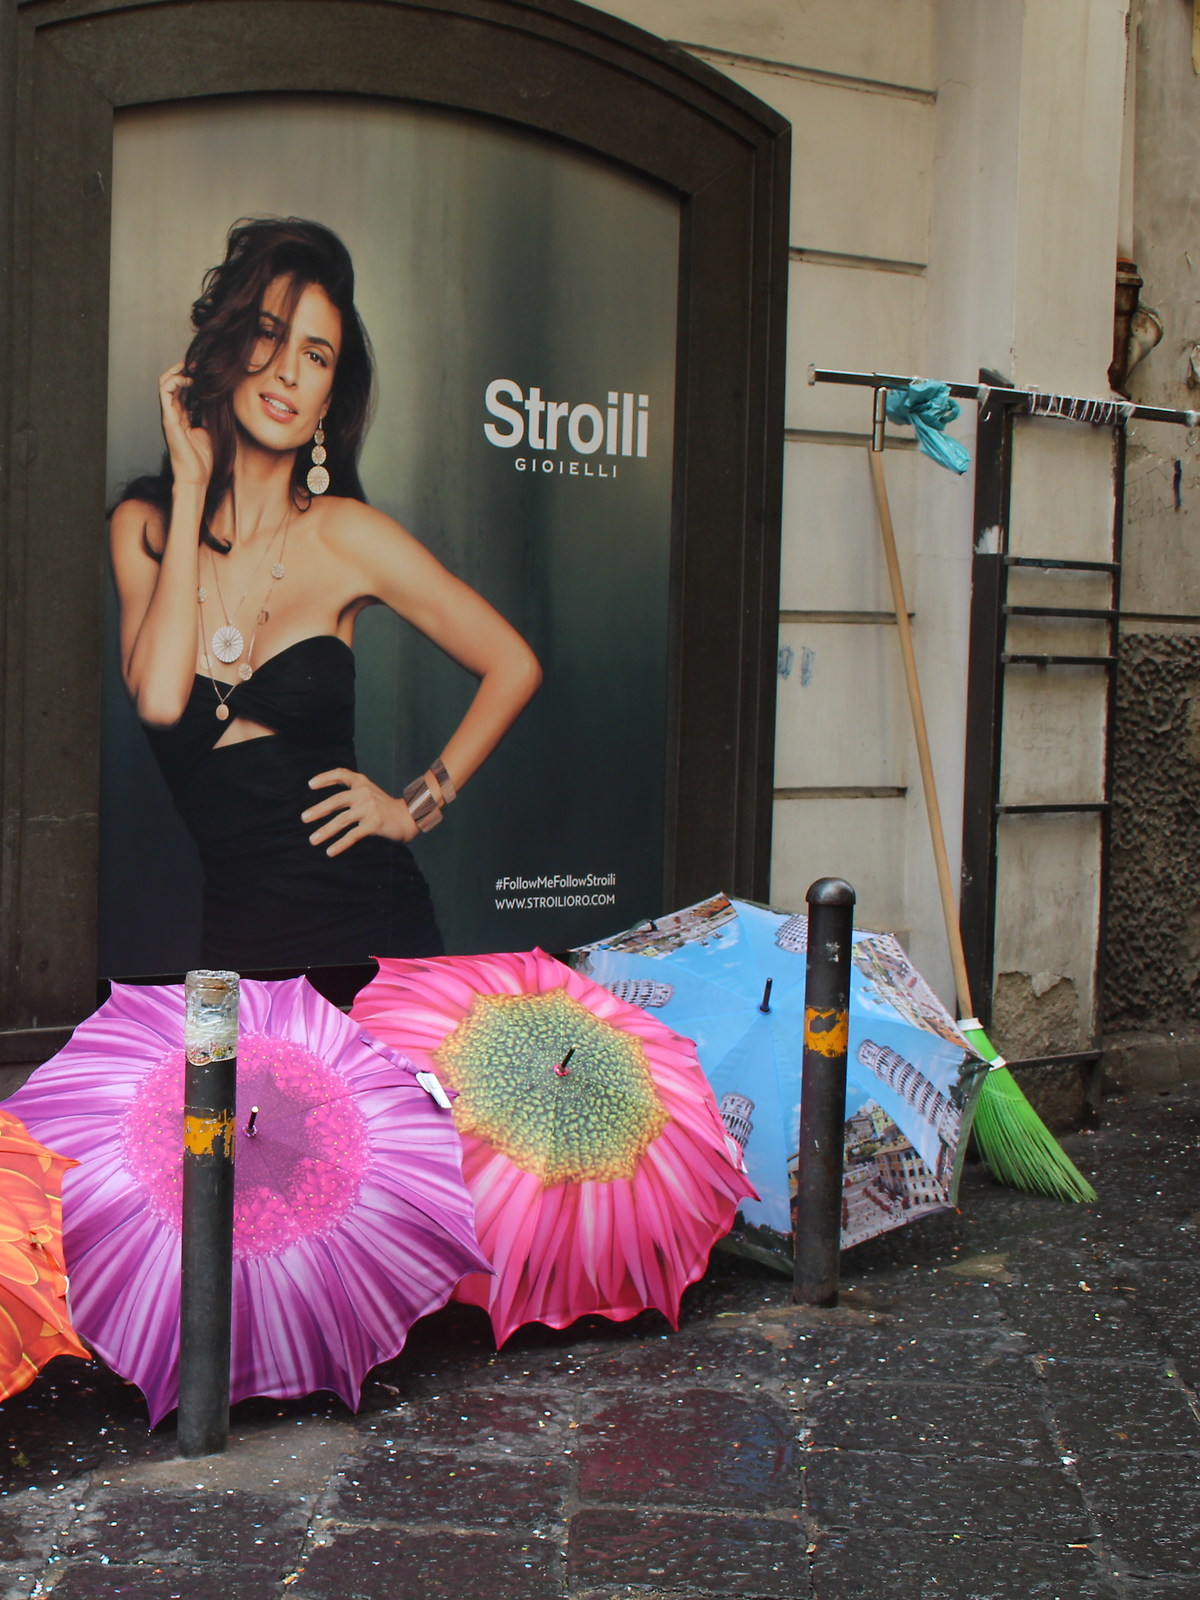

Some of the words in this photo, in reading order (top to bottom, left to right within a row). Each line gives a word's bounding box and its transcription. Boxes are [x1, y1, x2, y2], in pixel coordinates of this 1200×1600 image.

[484, 378, 649, 458] Stroili
[515, 457, 617, 478] GIOIELLI
[495, 873, 616, 891] #FollowMeFollowStroili
[495, 894, 616, 910] WWW.STROILIORO.COM
